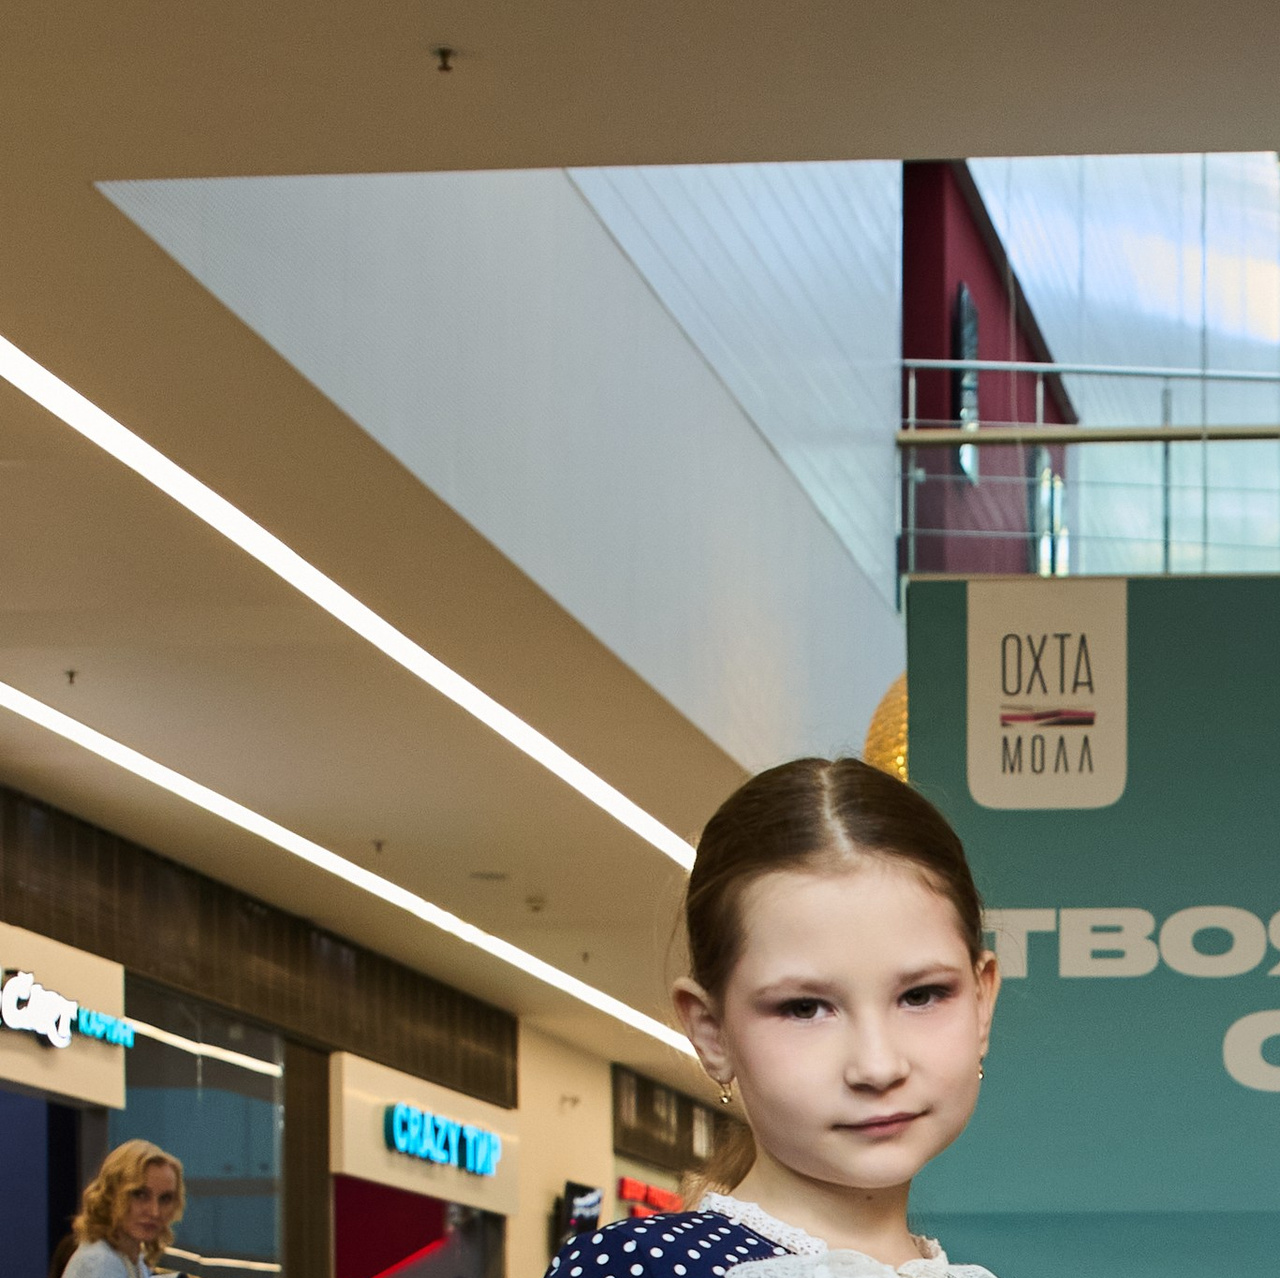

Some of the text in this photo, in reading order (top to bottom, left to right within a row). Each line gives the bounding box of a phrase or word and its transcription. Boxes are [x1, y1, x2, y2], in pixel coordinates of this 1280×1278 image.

[1001, 632, 1095, 696] ОХТА
[1001, 733, 1094, 775] МОЛЛ
[390, 1101, 503, 1177] CRAZY ТИР
